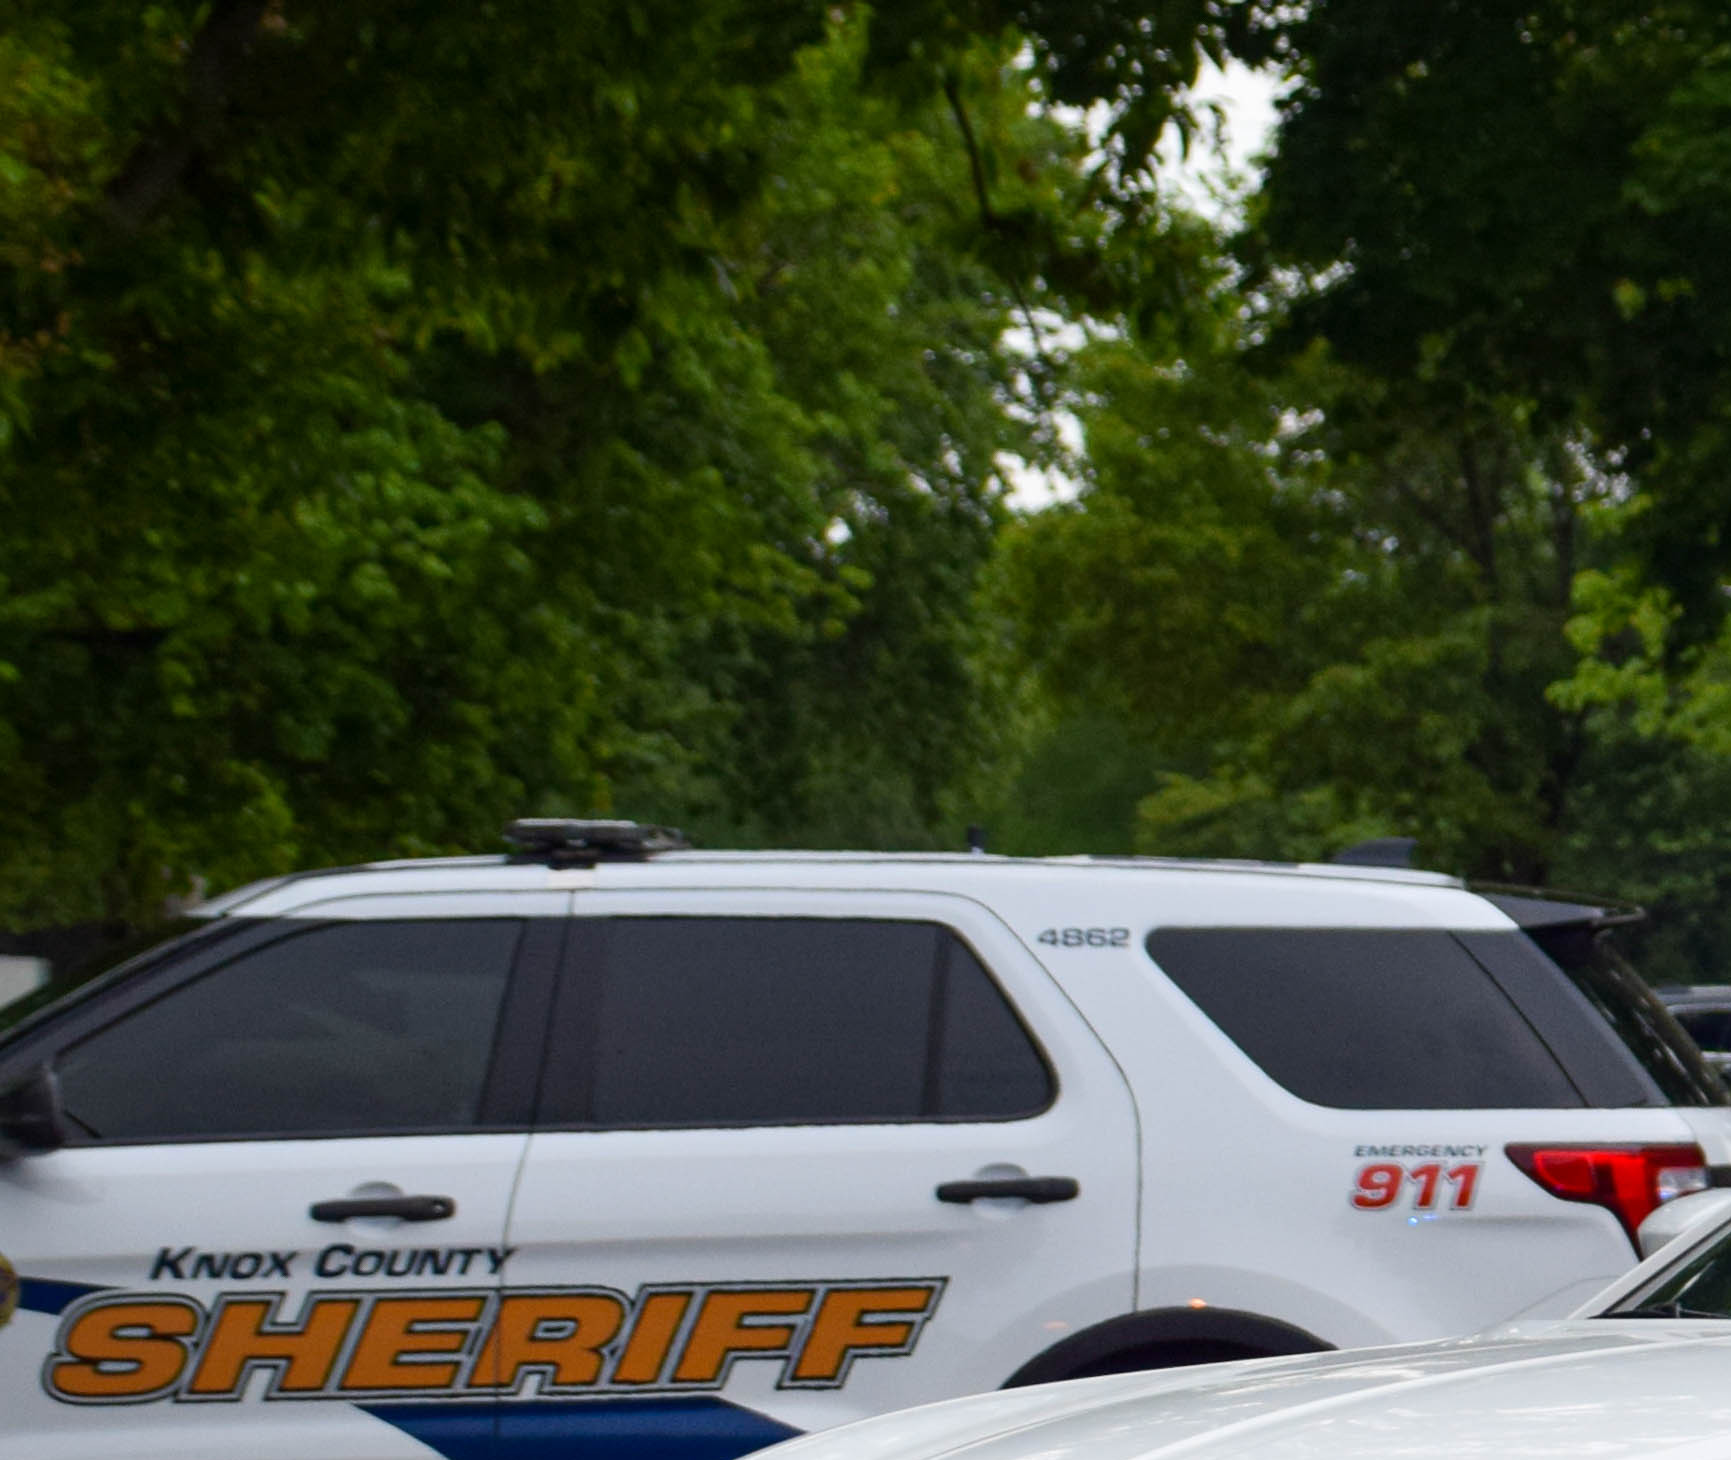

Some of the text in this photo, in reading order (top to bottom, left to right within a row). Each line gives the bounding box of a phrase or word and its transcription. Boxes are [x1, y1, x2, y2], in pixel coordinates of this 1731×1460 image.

[1038, 928, 1130, 946] 4862
[1354, 1144, 1487, 1157] EMERGENCY
[1349, 1160, 1486, 1212] 911
[42, 1278, 948, 1403] SHERIFF
